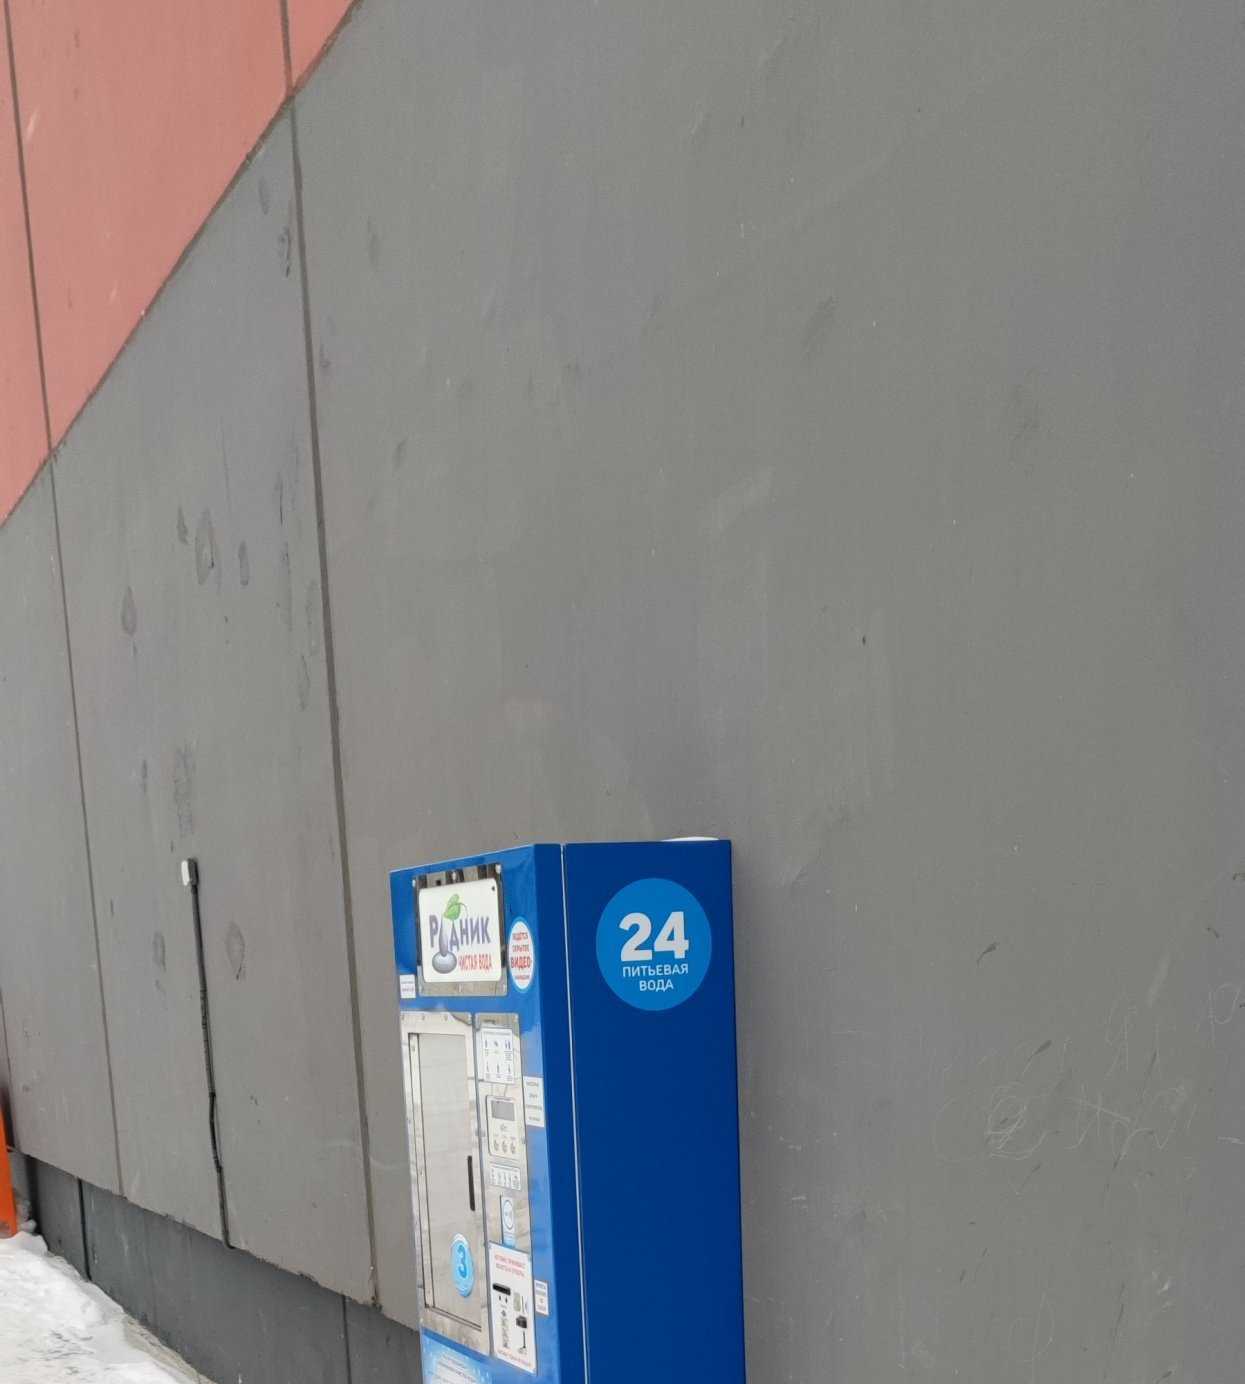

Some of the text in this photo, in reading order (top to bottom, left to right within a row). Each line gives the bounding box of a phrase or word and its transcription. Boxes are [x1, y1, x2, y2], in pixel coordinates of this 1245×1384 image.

[619, 911, 690, 962] 24
[478, 953, 493, 971] ВОДА
[510, 956, 531, 970] ВИДЕО
[622, 964, 688, 977] ПИТЬЕВАЯ
[639, 979, 674, 992] ВОДА
